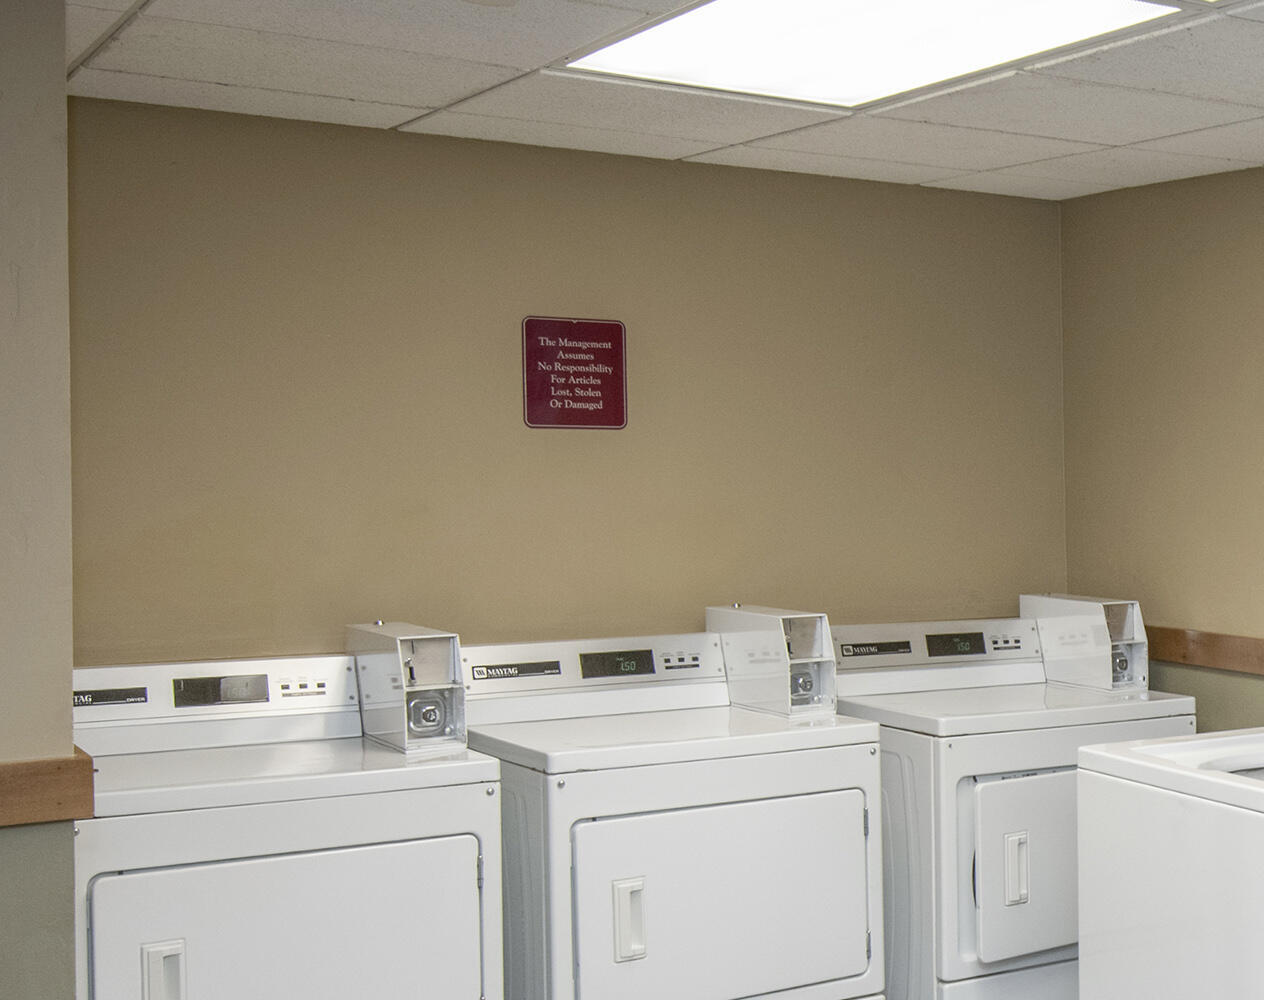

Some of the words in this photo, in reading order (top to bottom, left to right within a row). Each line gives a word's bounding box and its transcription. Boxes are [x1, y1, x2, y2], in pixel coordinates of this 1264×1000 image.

[538, 336, 556, 347] The
[559, 338, 612, 350] Management
[557, 350, 595, 361] Assumes
[538, 361, 552, 372] No
[555, 362, 614, 375] Responsibility
[551, 374, 566, 384] For
[568, 376, 602, 385] Articles
[575, 387, 602, 397] Stolen
[550, 399, 562, 409] Or
[565, 400, 604, 411] Damaged
[487, 663, 518, 676] MAYTAG
